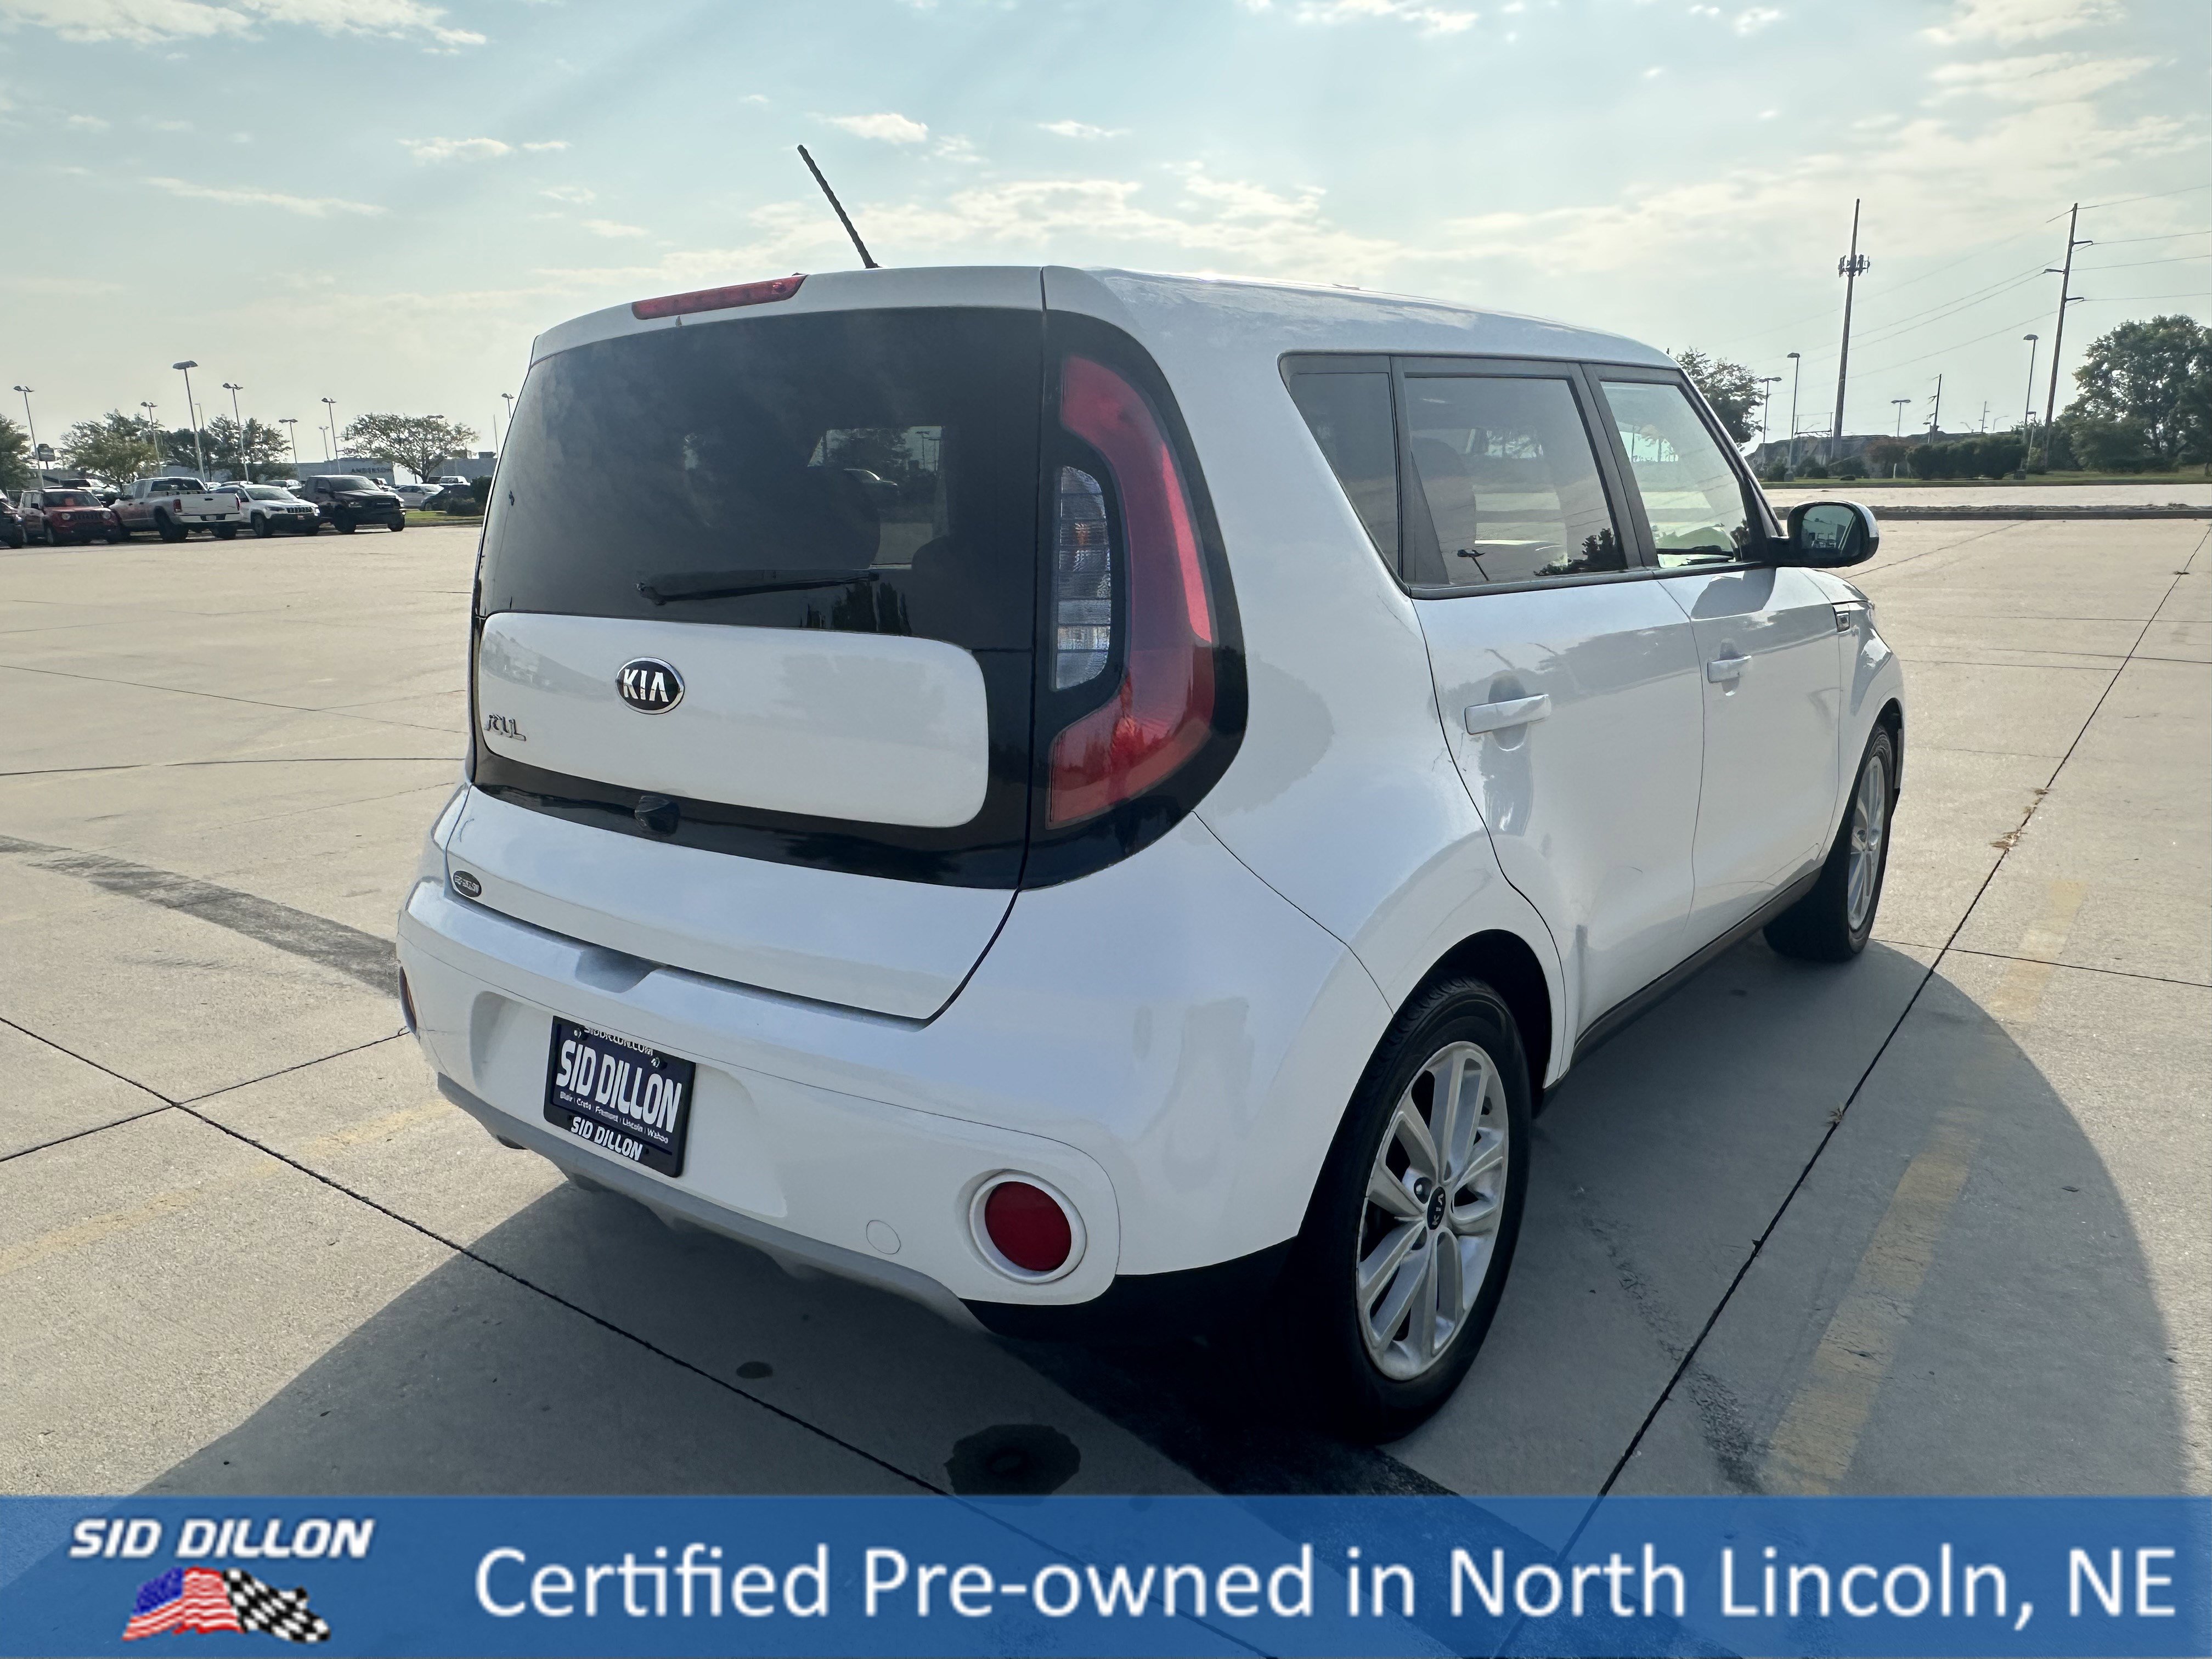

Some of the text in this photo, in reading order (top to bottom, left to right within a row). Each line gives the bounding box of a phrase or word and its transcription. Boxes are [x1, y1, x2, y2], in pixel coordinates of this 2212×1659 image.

[623, 668, 669, 702] KIA
[556, 1039, 682, 1133] SID DILLON
[571, 1116, 644, 1161] SID DILLON
